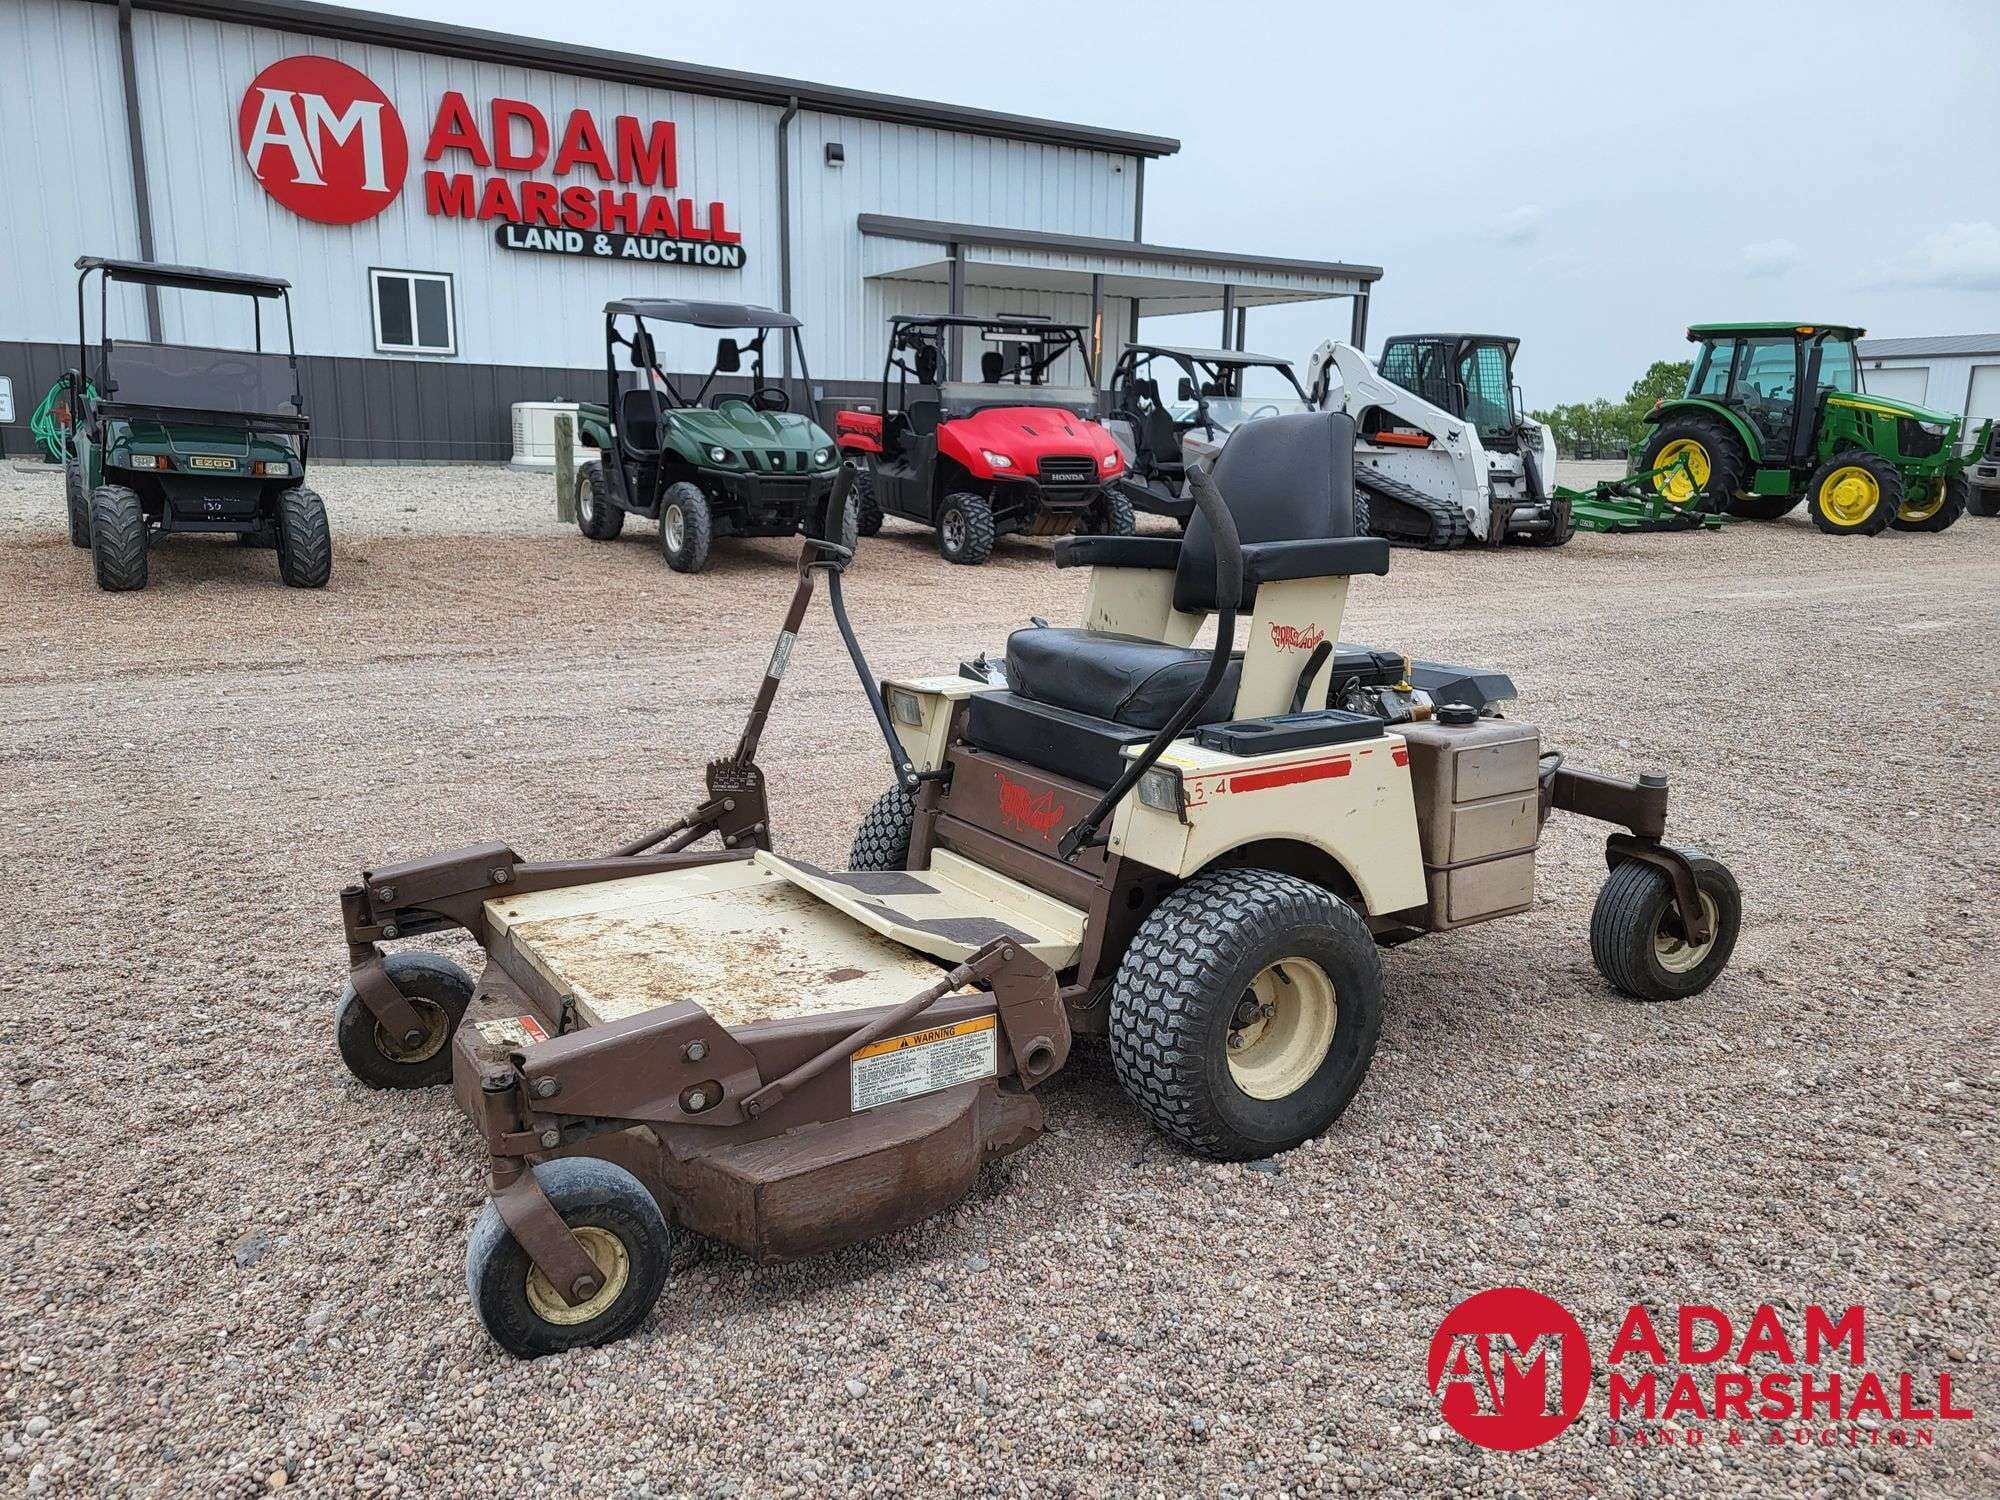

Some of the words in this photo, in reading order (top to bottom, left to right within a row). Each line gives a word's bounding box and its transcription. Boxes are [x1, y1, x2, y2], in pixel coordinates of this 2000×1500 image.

[247, 87, 391, 192] AM
[424, 91, 678, 188] ADAM
[424, 170, 742, 243] MARSHALL
[506, 226, 584, 253] LAND
[593, 233, 613, 256] &
[621, 236, 739, 267] AUCTION
[1051, 473, 1086, 481] HONDA
[913, 1027, 956, 1044] WARNING
